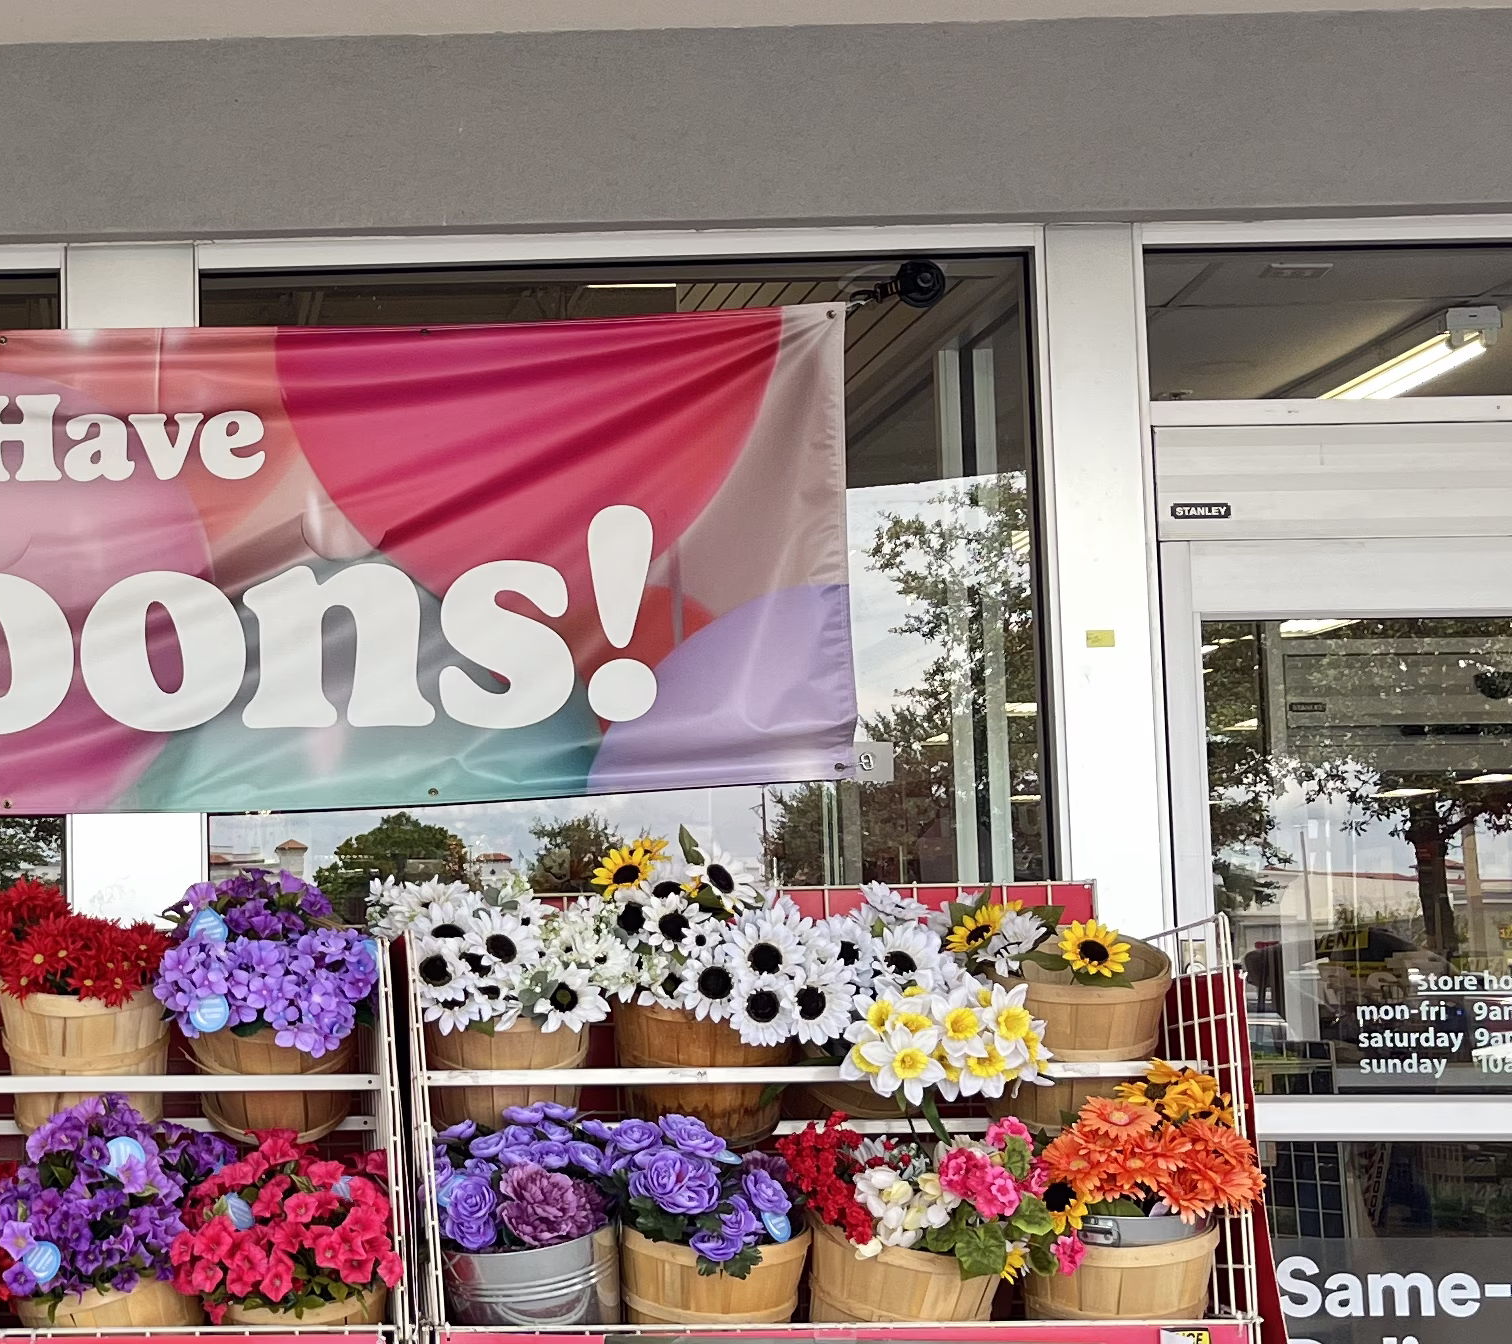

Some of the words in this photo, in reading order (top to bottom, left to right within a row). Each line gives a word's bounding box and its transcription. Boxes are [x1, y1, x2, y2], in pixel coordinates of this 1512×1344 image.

[1175, 506, 1227, 516] STANLEY
[1417, 971, 1478, 991] store
[1356, 1000, 1447, 1021] mon-fri
[1358, 1026, 1464, 1052] saturday
[1360, 1053, 1448, 1078] sunday
[1276, 1255, 1512, 1318] Same-
